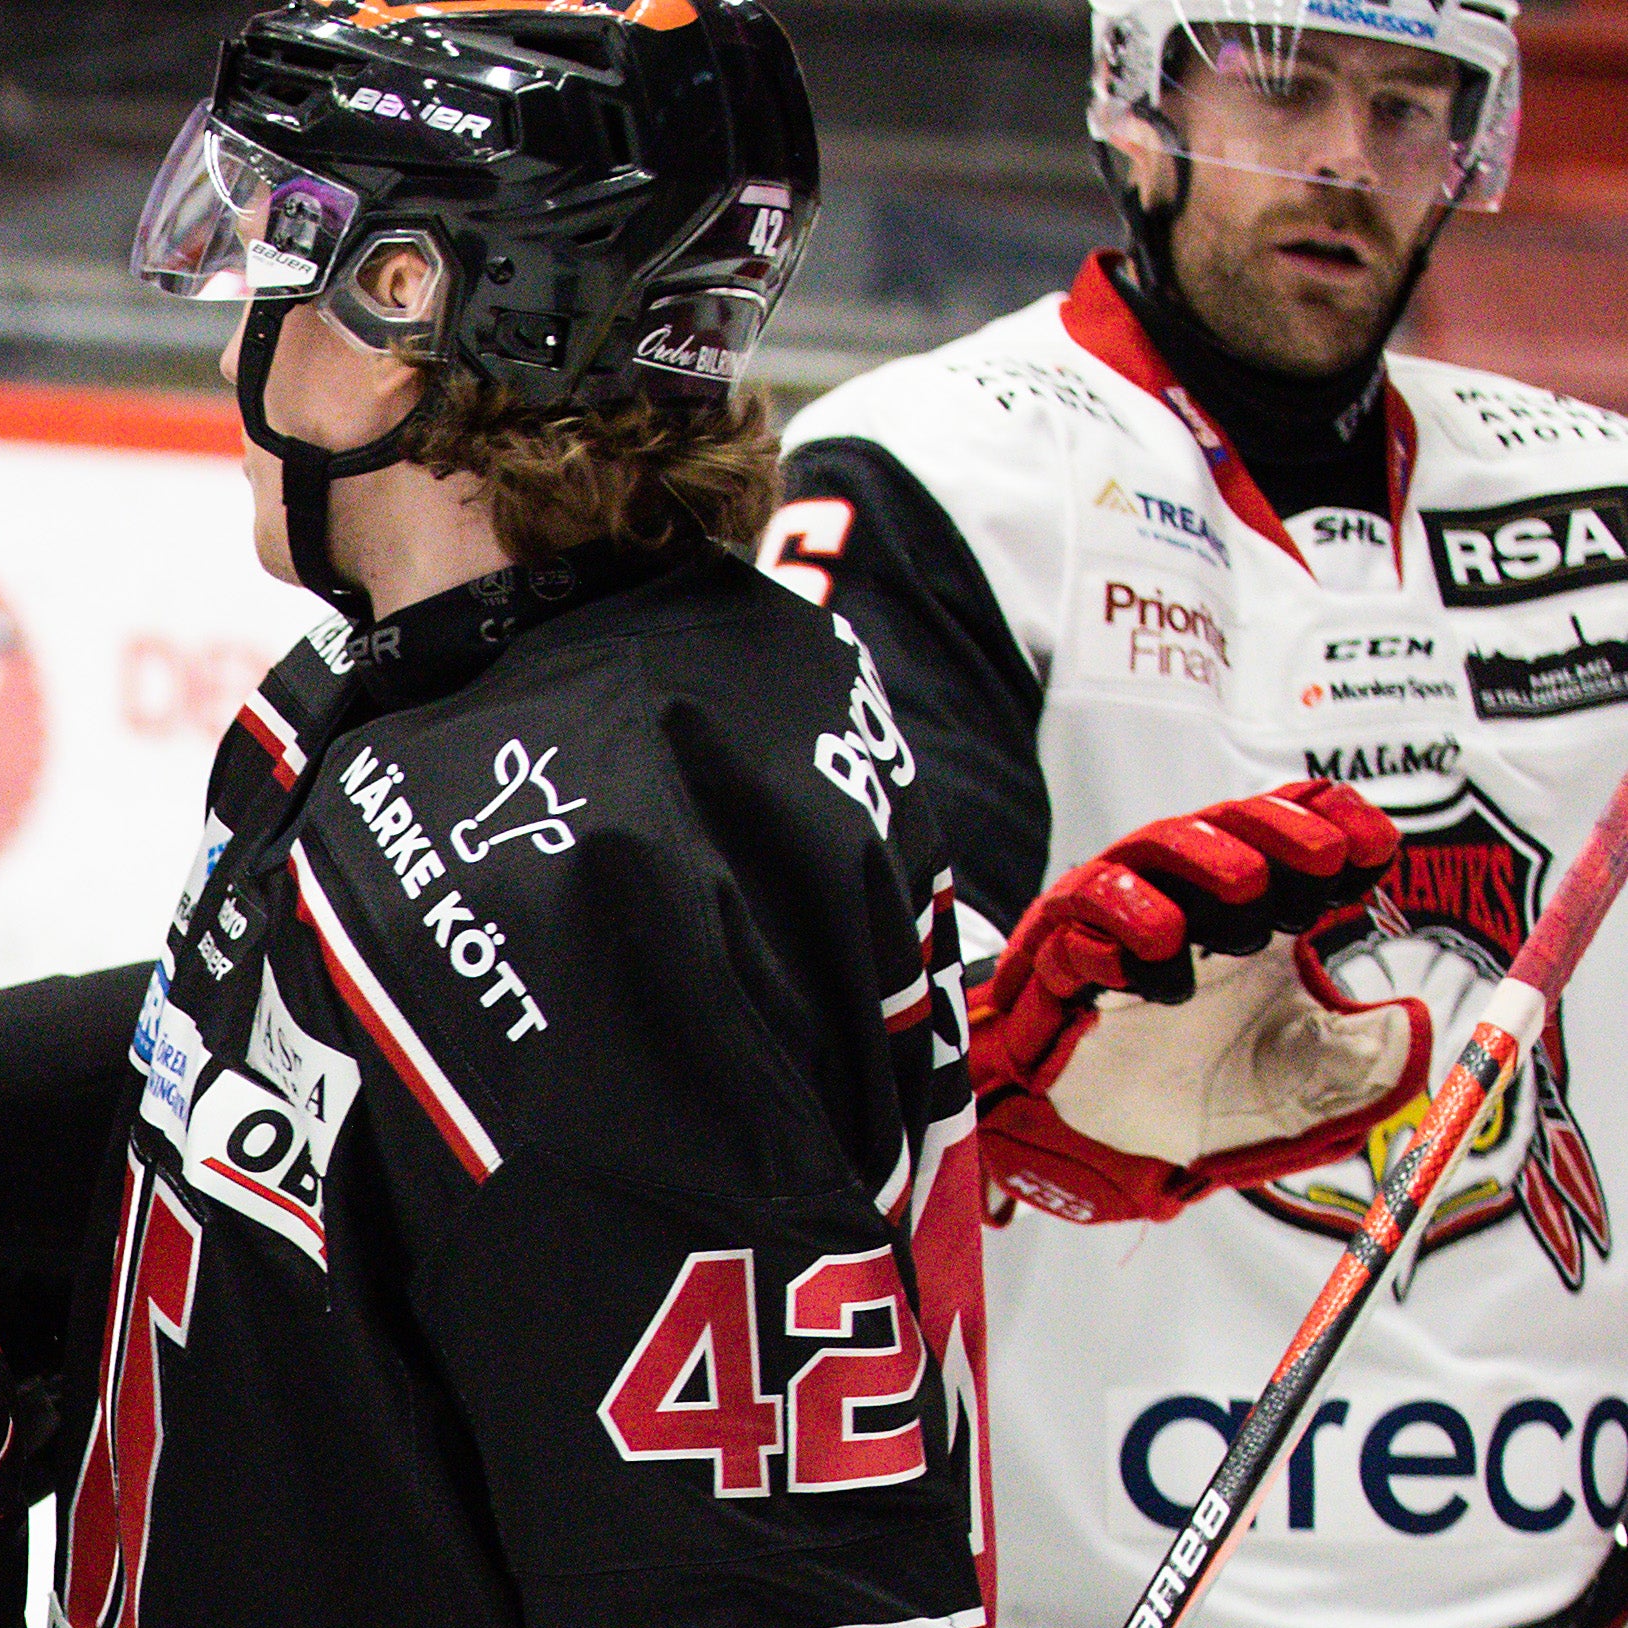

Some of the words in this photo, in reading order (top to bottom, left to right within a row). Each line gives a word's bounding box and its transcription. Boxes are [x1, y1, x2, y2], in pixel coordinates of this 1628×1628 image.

[747, 207, 784, 257] 42
[1312, 514, 1387, 546] SHL
[1442, 507, 1628, 586] RSA
[338, 746, 445, 903] NÄRKE
[424, 892, 548, 1042] KÖTT
[596, 1244, 929, 1499] 42
